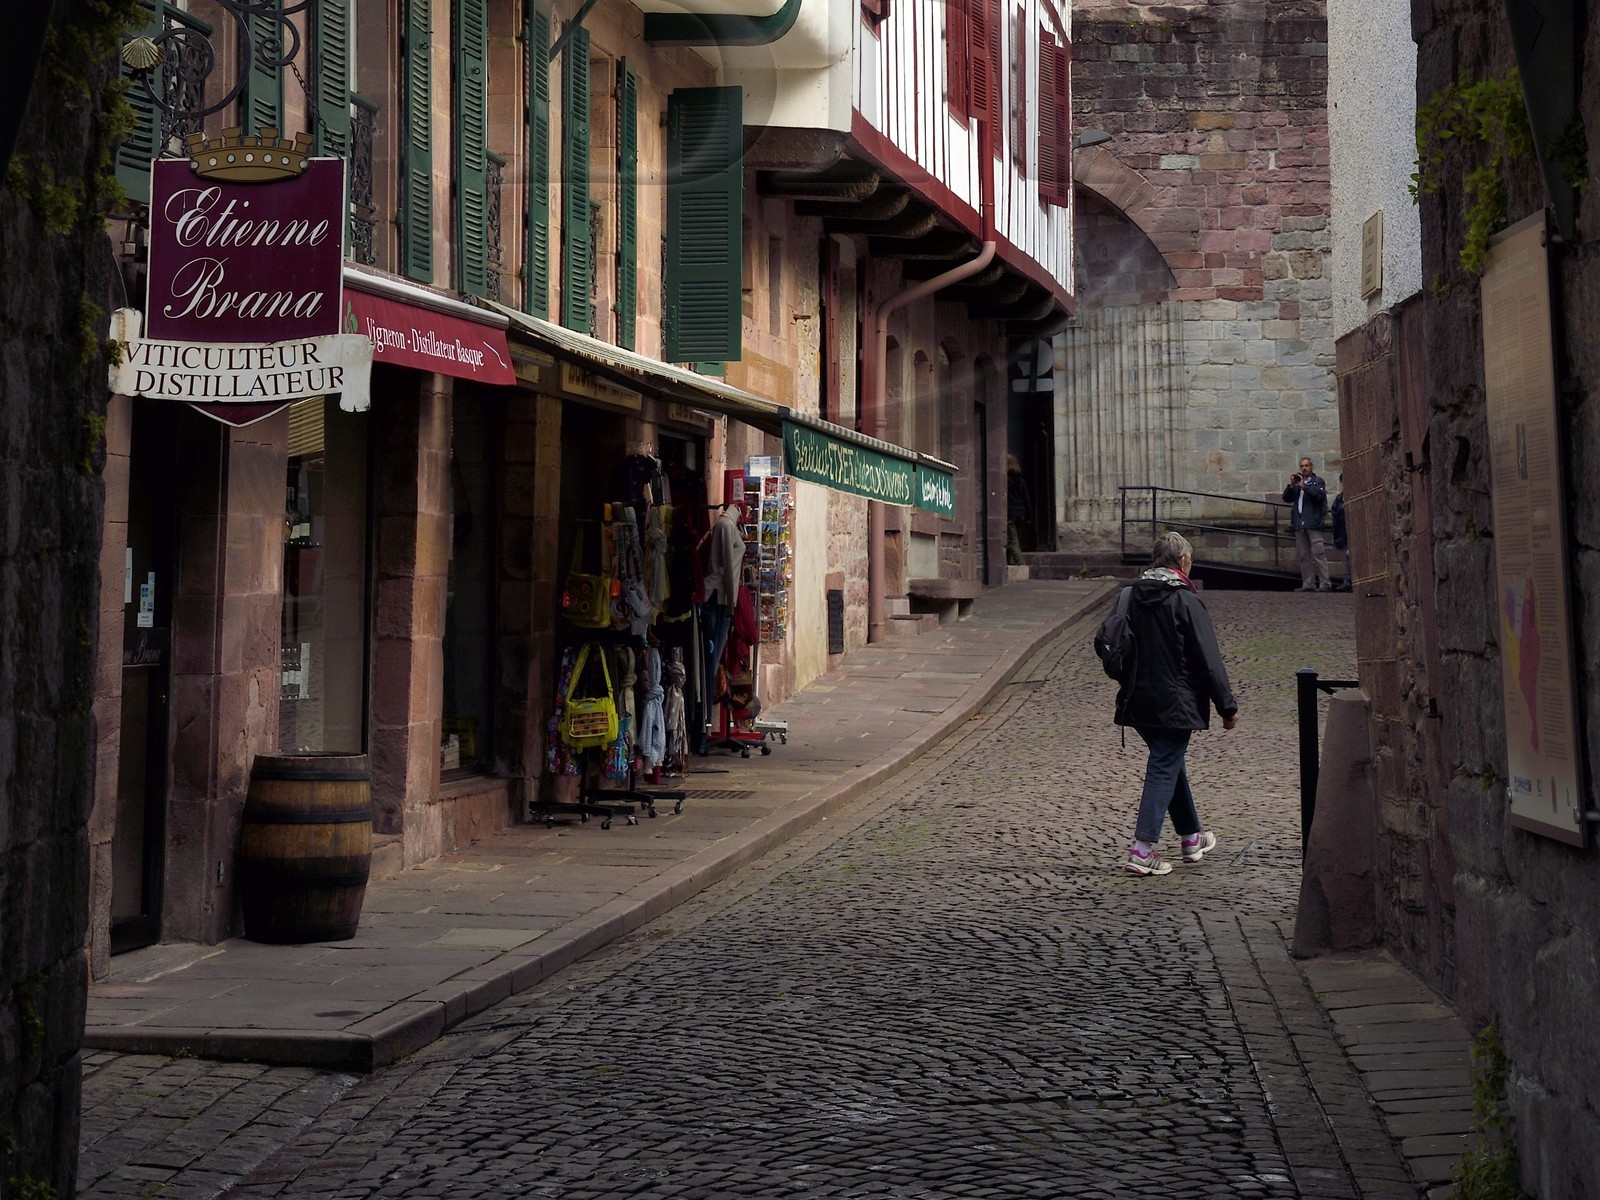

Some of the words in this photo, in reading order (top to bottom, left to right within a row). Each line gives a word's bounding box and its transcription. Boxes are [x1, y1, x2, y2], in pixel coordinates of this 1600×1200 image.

[164, 185, 329, 247] Etienne
[163, 257, 324, 319] Brana
[124, 342, 321, 369] VITICULTEUR
[366, 317, 406, 353] Vigneron
[411, 328, 456, 361] Distillateur
[455, 339, 485, 372] Basque
[135, 366, 344, 397] DISTILLATEUR
